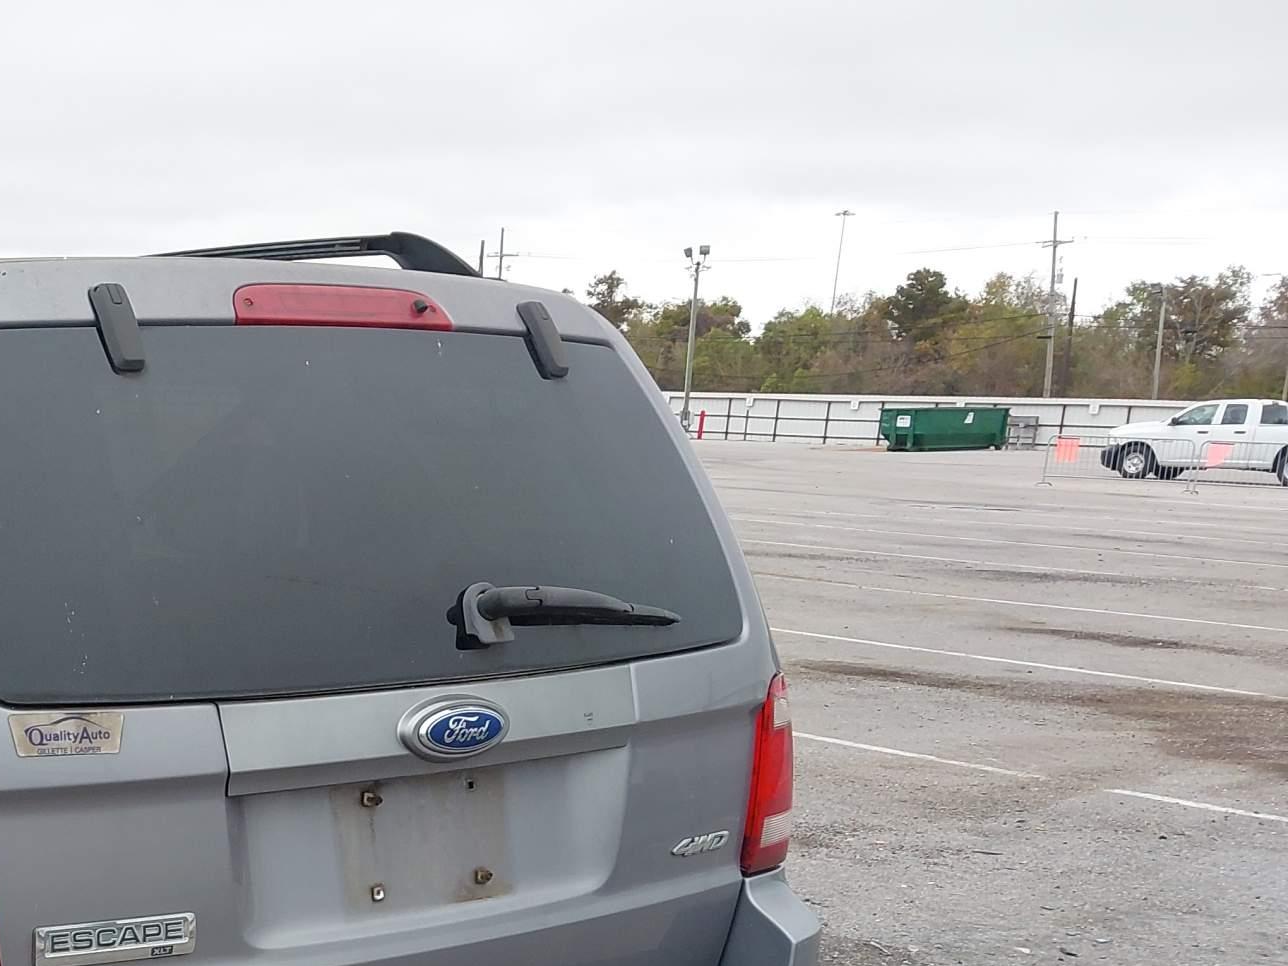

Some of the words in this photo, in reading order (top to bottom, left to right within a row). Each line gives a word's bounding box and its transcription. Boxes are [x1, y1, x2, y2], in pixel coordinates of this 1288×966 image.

[444, 715, 491, 744] Ford
[49, 920, 186, 953] ESCAPE
[152, 946, 173, 955] XLT
